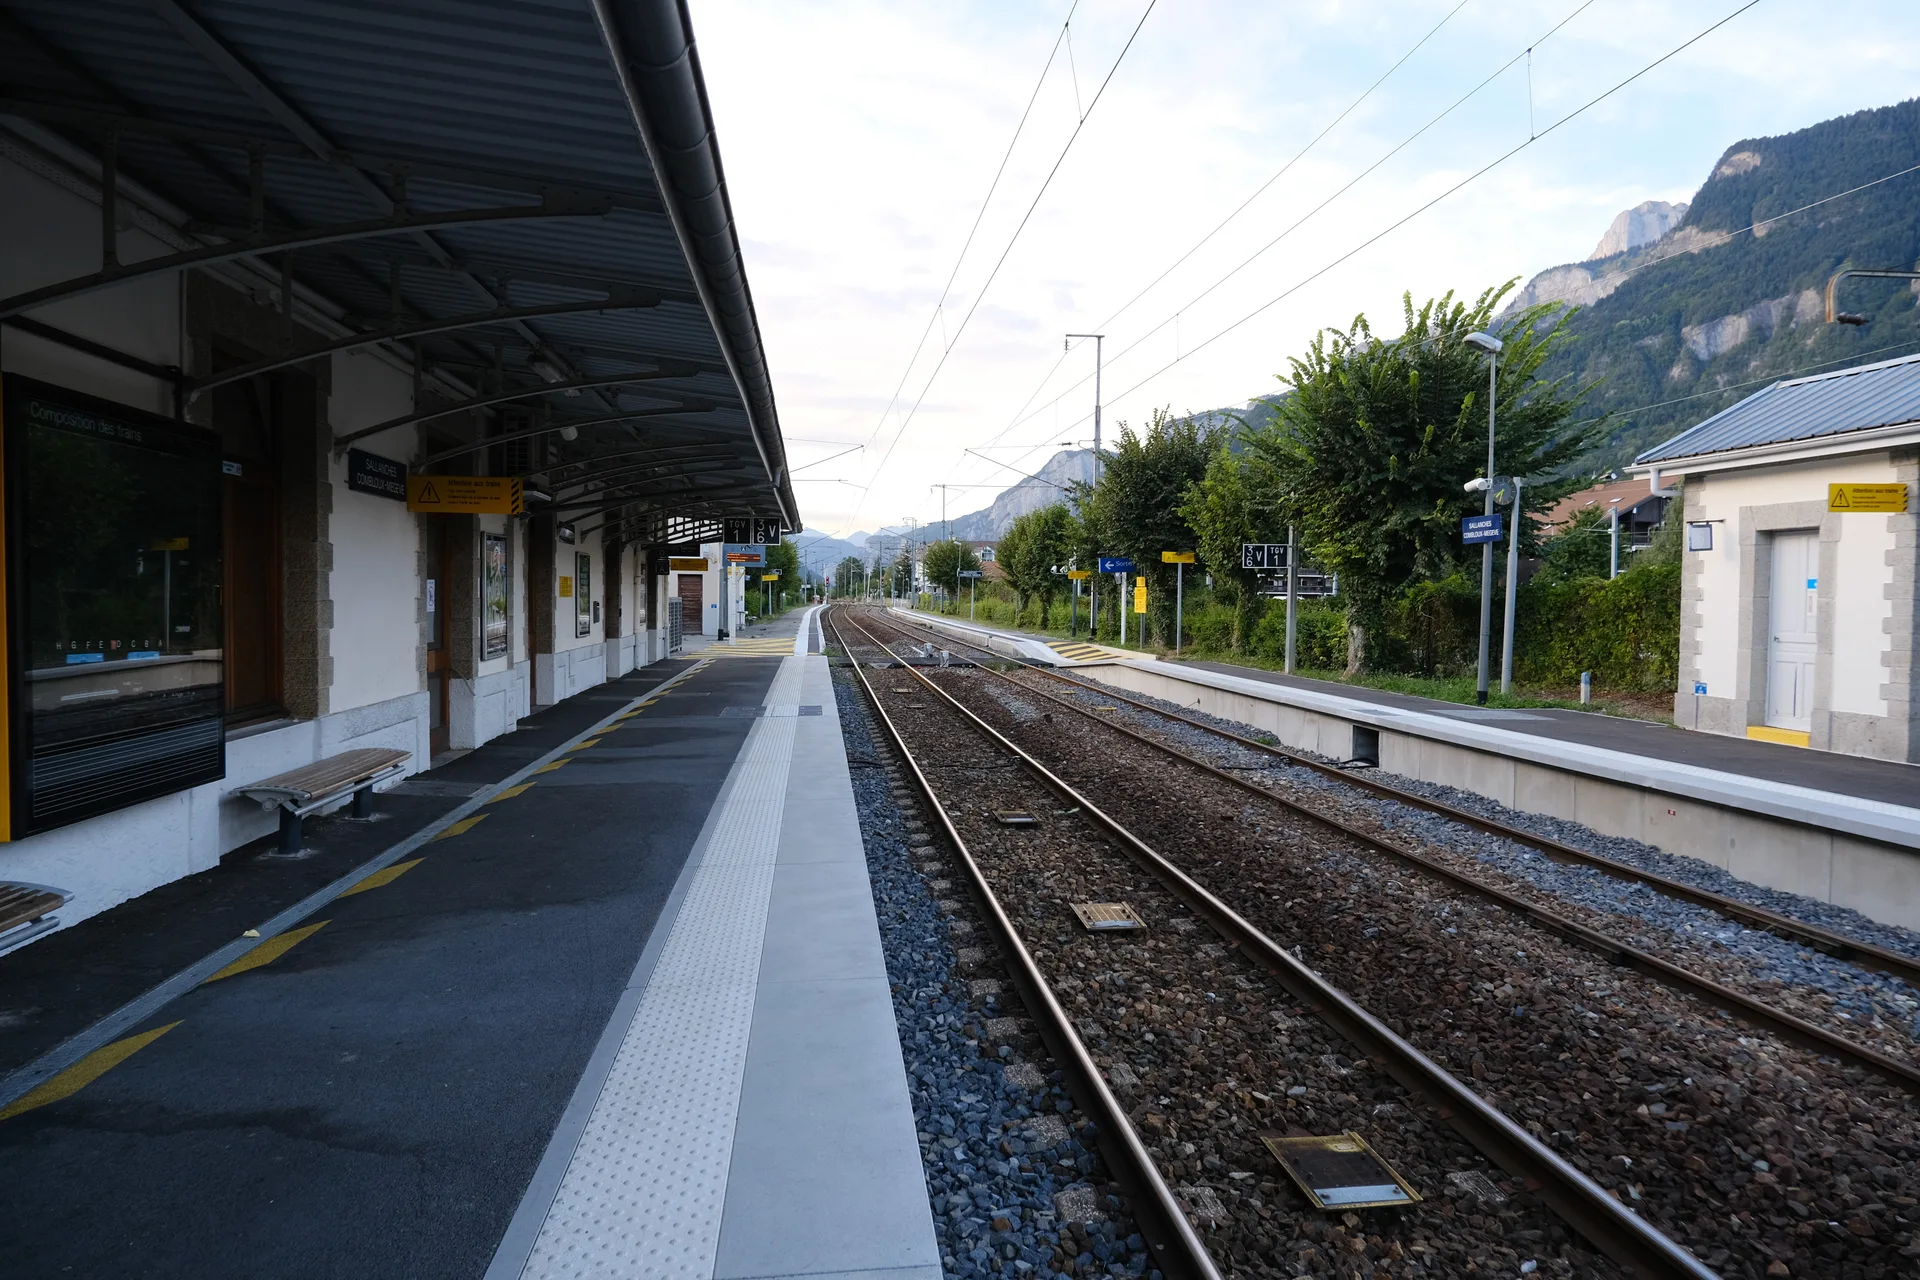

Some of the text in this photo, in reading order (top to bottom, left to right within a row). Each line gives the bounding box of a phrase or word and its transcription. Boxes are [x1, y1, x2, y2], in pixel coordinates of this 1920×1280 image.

[30, 401, 142, 441] Composition des trains
[365, 458, 397, 478] SALLANCHES
[729, 520, 746, 529] TGV
[756, 519, 765, 531] 3
[1468, 520, 1492, 529] SALLANCHES
[733, 529, 739, 542] 1
[756, 531, 765, 543] 6
[768, 525, 777, 538] V
[1246, 545, 1253, 556] 3
[1256, 551, 1262, 562] V
[1246, 556, 1253, 567] 6
[1273, 554, 1278, 566] 1
